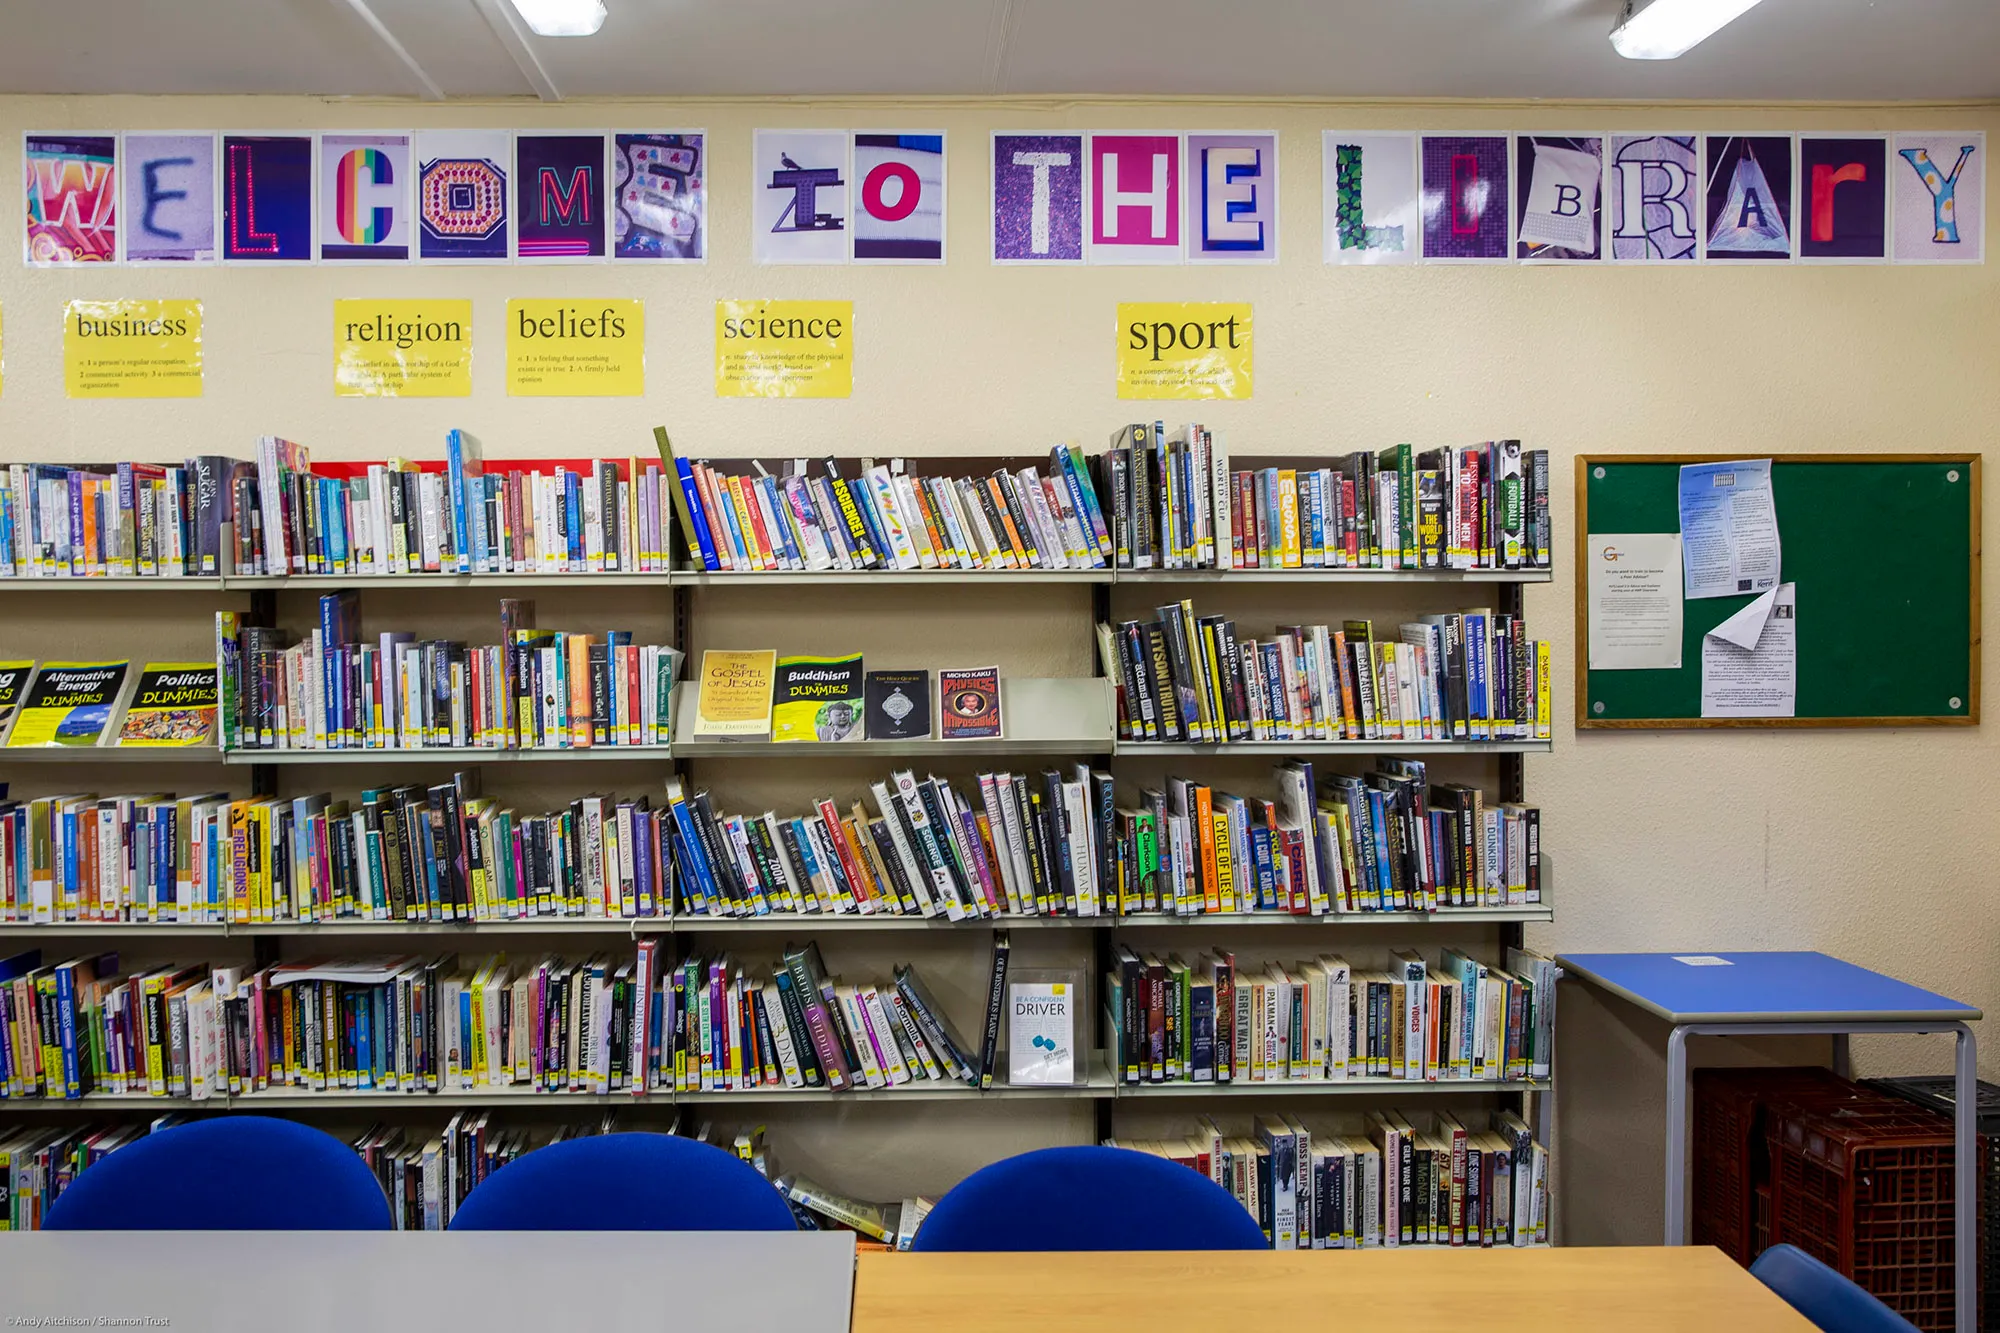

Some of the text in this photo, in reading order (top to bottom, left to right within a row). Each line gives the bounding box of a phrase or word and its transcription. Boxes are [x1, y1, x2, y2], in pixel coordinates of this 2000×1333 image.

[30, 142, 698, 253] WELCOME
[767, 161, 921, 233] TO
[1013, 146, 1264, 252] THE
[77, 313, 187, 337] business
[345, 314, 463, 349] religion
[517, 308, 626, 338] beliefs
[724, 309, 842, 339] science
[1129, 315, 1241, 361] sport
[124, 371, 148, 380] activity
[576, 355, 609, 363] something
[585, 365, 604, 374] firmly
[200, 465, 210, 510] SUGAR
[1133, 448, 1143, 508] MANCHESTER
[1217, 459, 1225, 496] WORLD
[1470, 461, 1478, 522] JESSICA ENNIS
[187, 484, 196, 520] Branson
[392, 486, 400, 517] Religion
[1303, 496, 1311, 521] ROGER
[1424, 513, 1438, 525] THE
[1135, 511, 1144, 547] UNITED
[1420, 524, 1443, 535] WORLD
[1424, 534, 1438, 546] CUP
[1461, 523, 1470, 541] MEN
[250, 631, 259, 717] RICHARD DAWKINS
[519, 653, 527, 689] Hinduism
[711, 668, 765, 679] GOSPEL
[730, 661, 748, 670] THE
[788, 669, 850, 683] Buddhism
[947, 670, 992, 680] MICHIO KAKU
[1120, 640, 1135, 697] NICOLA ADAMS
[1216, 623, 1232, 694] RUNNING SCIENCE
[1516, 625, 1526, 719] LEWIS HAMILTON
[46, 669, 116, 684] Alternative
[56, 680, 102, 693] Energy
[156, 673, 216, 687] Politics
[707, 677, 766, 689] OF JESUS
[789, 683, 849, 697] DUMMIES
[944, 678, 996, 696] PHYSICS
[1135, 664, 1147, 699] adams
[1150, 636, 1177, 721] TYSON TRUTH
[1358, 657, 1373, 704] CALZAGHE
[41, 693, 104, 708] DUMMIES
[142, 687, 218, 705] DUMMIES
[943, 709, 998, 728] IMPOSSIBLE
[983, 786, 1001, 828] WEATHER
[1002, 786, 1022, 855] SPACEWATCHING
[1103, 783, 1114, 824] BIOLOGY
[1188, 787, 1199, 849] Michael Schumacher
[1204, 817, 1209, 825] TO
[922, 790, 954, 866] planet earth
[1156, 800, 1166, 848] Hamilton
[1358, 785, 1372, 866] MEMORIES OF STEAM
[469, 828, 479, 859] Judaism
[922, 828, 943, 867] SCIENCE
[967, 822, 985, 871] raging planet
[1142, 833, 1152, 872] Clarkson
[1216, 821, 1230, 893] CYCLE OF LIES
[1269, 830, 1282, 871] CYCLING
[1487, 827, 1496, 872] DUNKIRK
[233, 836, 247, 893] RELIGIONS
[768, 858, 786, 885] ZOOM
[1291, 845, 1304, 893] CARS
[61, 1000, 71, 1028] BUSINESS
[148, 997, 158, 1043] Bookkeeping
[634, 984, 644, 1039] HINDUISM
[676, 1009, 684, 1034] Biology
[794, 966, 836, 1065] BRITISH WILDLIFE
[897, 1004, 918, 1041] Formula
[1016, 1003, 1066, 1016] DRIVER
[1237, 995, 1248, 1050] GREAT WAR
[1266, 992, 1275, 1025] PAXMAN
[1411, 1006, 1419, 1033] VOICES
[170, 1004, 181, 1049] BRANSON
[476, 1033, 484, 1063] HANDBOOK
[1299, 1137, 1307, 1187] ROSS KEMP
[1403, 1145, 1411, 1164] GULF
[1440, 1153, 1450, 1171] 617
[1236, 1161, 1245, 1194] DAMBUSTERS
[1468, 1152, 1478, 1196] LONE SURVIVOR
[1452, 1183, 1461, 1225] ANDY McNAB
